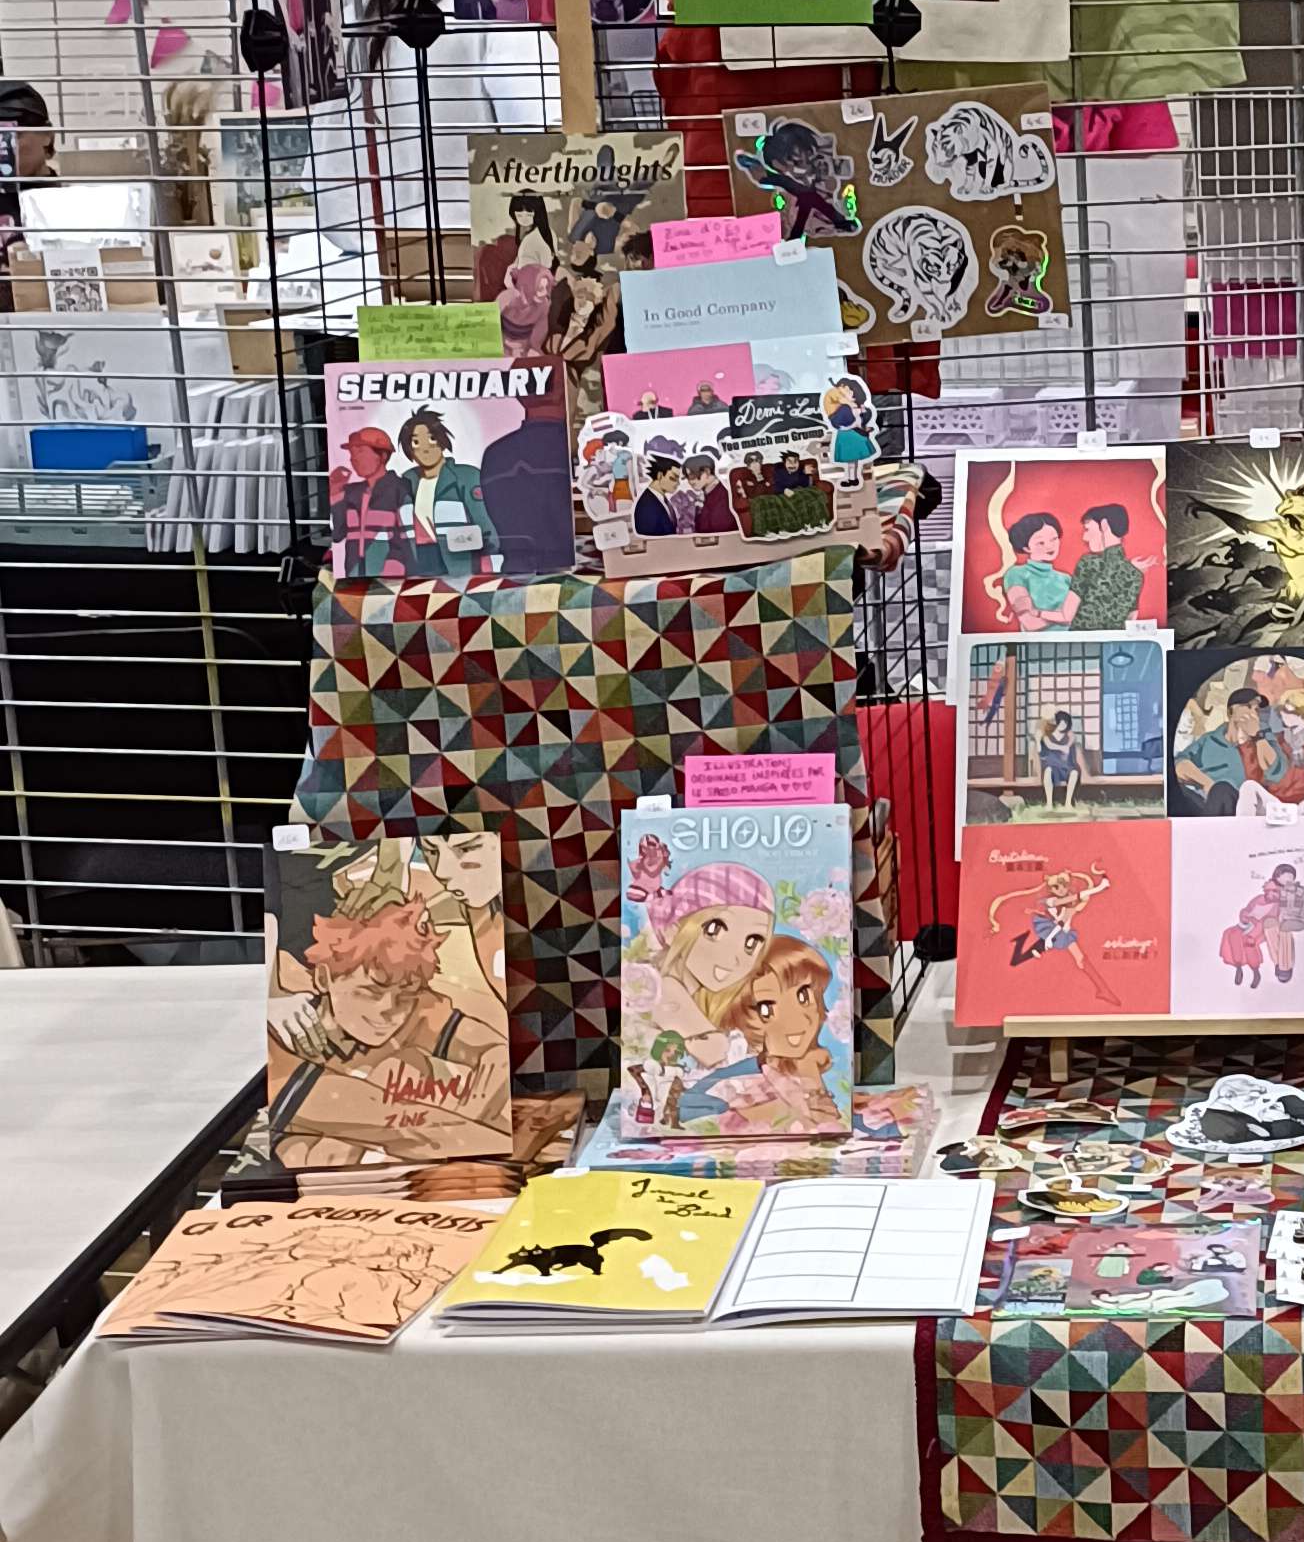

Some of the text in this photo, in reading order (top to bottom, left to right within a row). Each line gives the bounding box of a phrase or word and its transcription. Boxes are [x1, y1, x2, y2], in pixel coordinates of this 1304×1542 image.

[480, 156, 673, 187] Afterthoughts
[644, 300, 777, 322] In Good Company
[337, 365, 553, 402] SECONDARY
[741, 436, 773, 449] match
[774, 434, 789, 444] my
[671, 814, 812, 851] SHOJO
[384, 1110, 430, 1131] ZINE
[287, 1206, 497, 1232] CRUSH CRISIS
